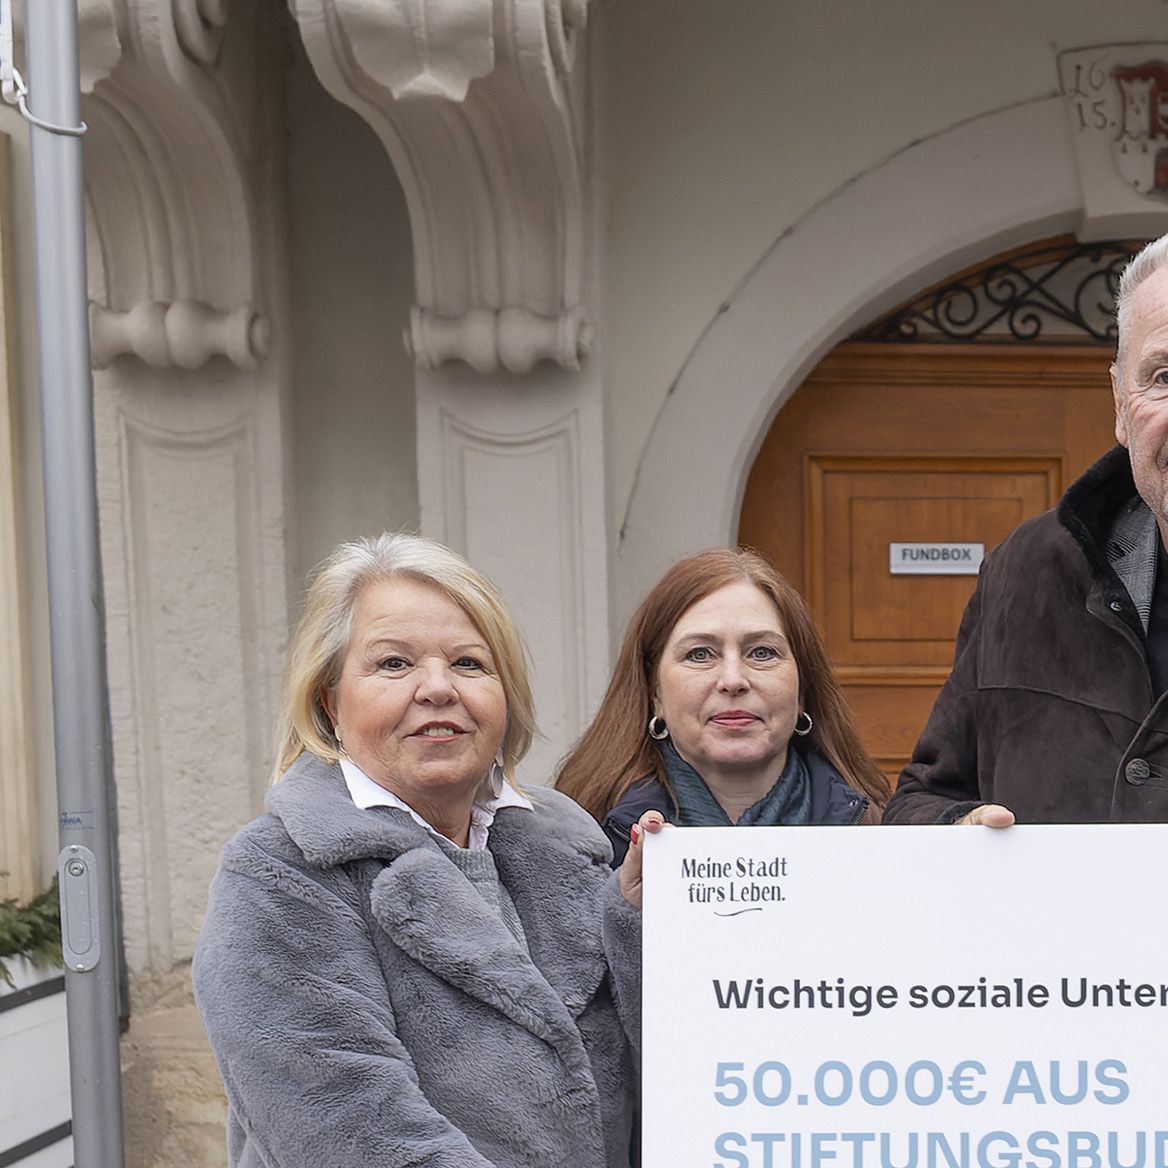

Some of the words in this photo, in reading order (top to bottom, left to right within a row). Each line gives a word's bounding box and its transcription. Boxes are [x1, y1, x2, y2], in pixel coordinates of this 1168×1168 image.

[902, 548, 972, 561] FUNDBOX
[681, 857, 732, 878] Meine
[735, 857, 788, 877] Stadt
[688, 883, 725, 903] fürs
[730, 882, 786, 902] Leben.
[712, 977, 898, 1017] Wichtige
[908, 976, 1050, 1009] soziale
[713, 1060, 988, 1107] 50.000€
[1002, 1059, 1130, 1105] AUS
